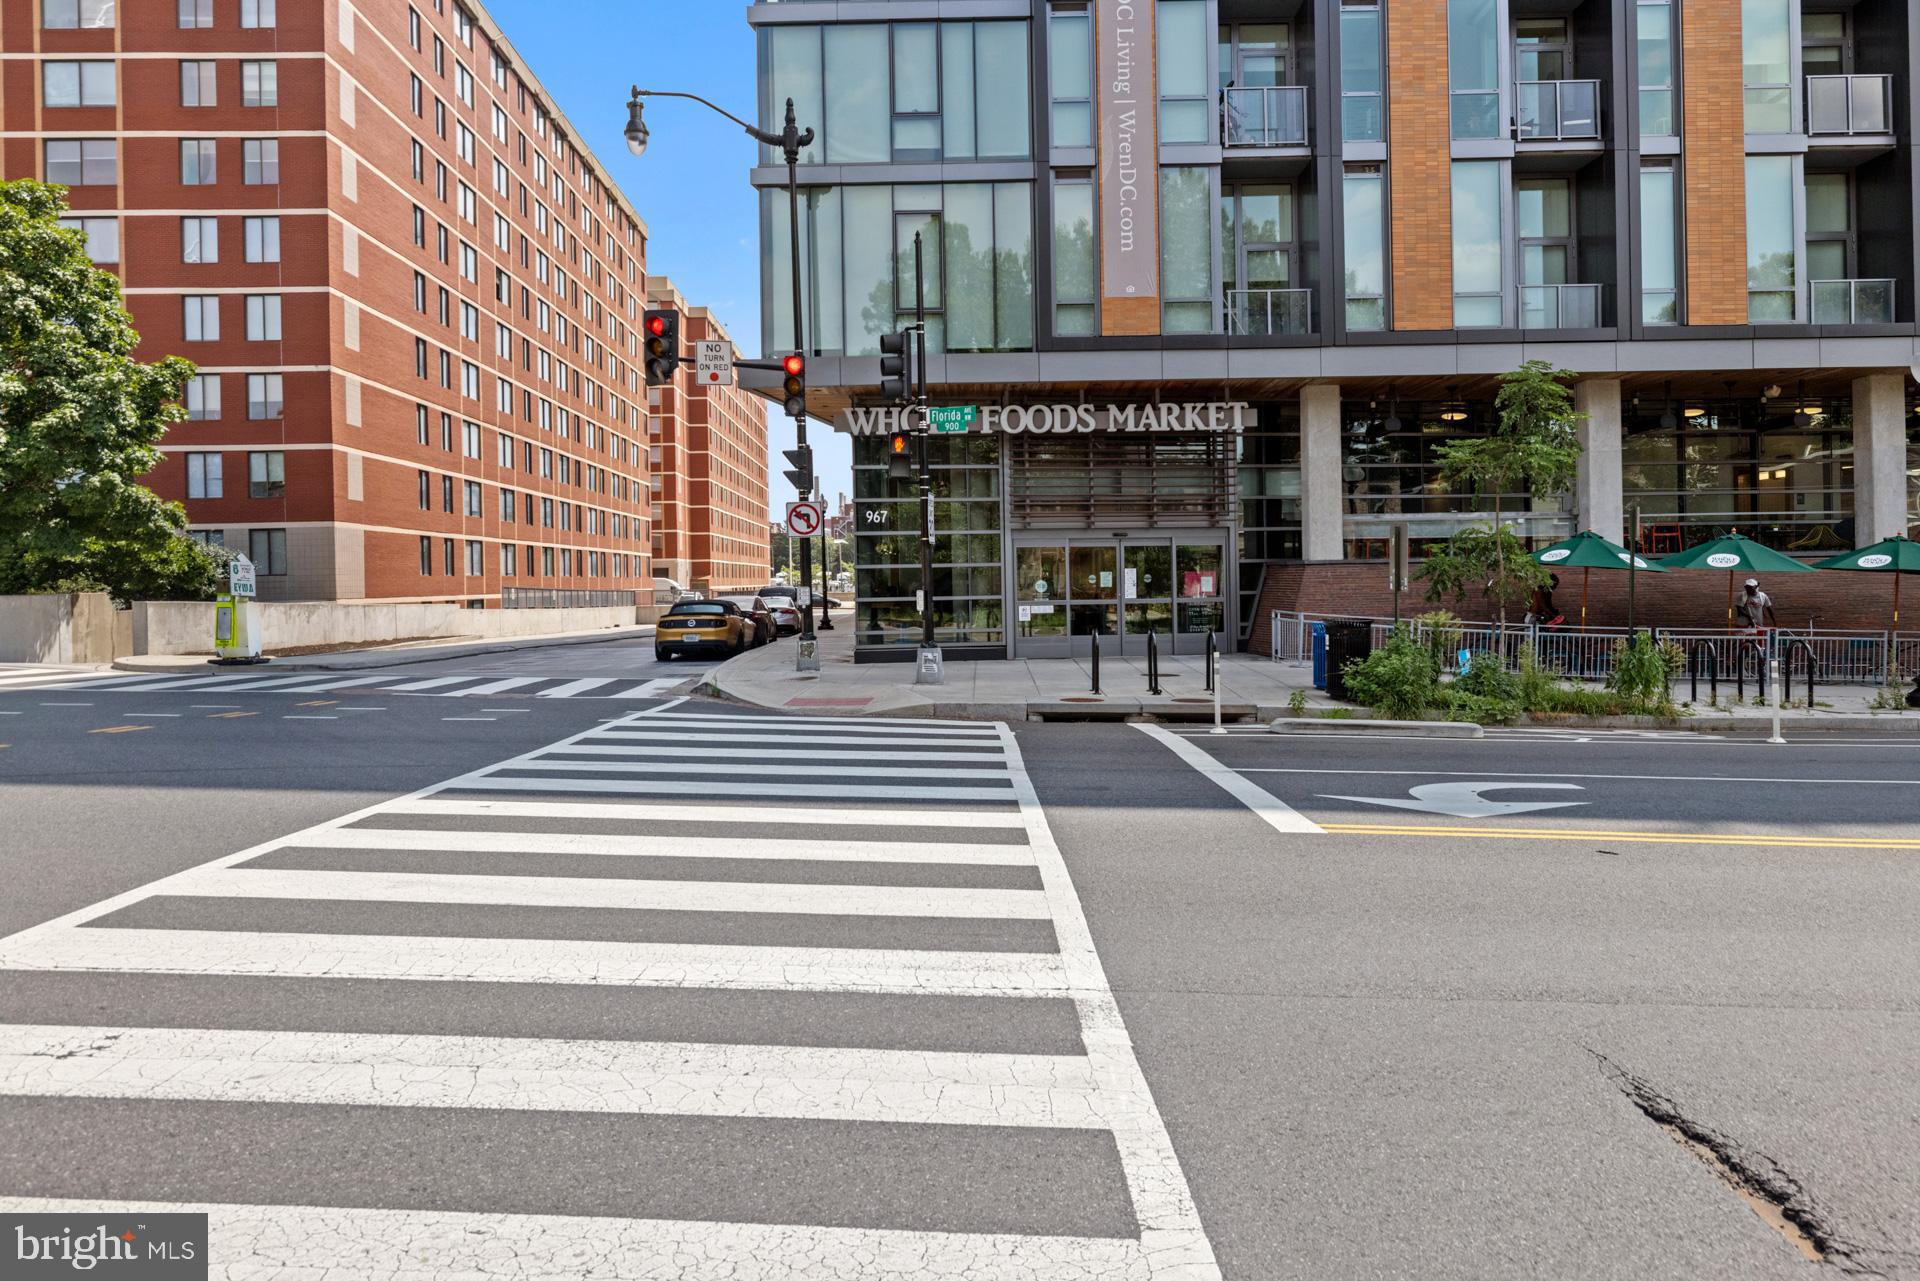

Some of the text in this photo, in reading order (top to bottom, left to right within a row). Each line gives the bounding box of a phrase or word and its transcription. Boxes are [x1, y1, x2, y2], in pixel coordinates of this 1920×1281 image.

[1116, 0, 1133, 20] C
[1113, 27, 1135, 93] Living
[1118, 109, 1137, 252] WrenDC.com
[706, 344, 722, 353] NO
[704, 354, 725, 362] TURN
[699, 363, 729, 371] ON RED
[931, 410, 961, 422] Florida
[980, 404, 1096, 434] FOODS
[1107, 401, 1249, 432] MARKET
[944, 422, 960, 431] 900
[865, 510, 888, 523] 967
